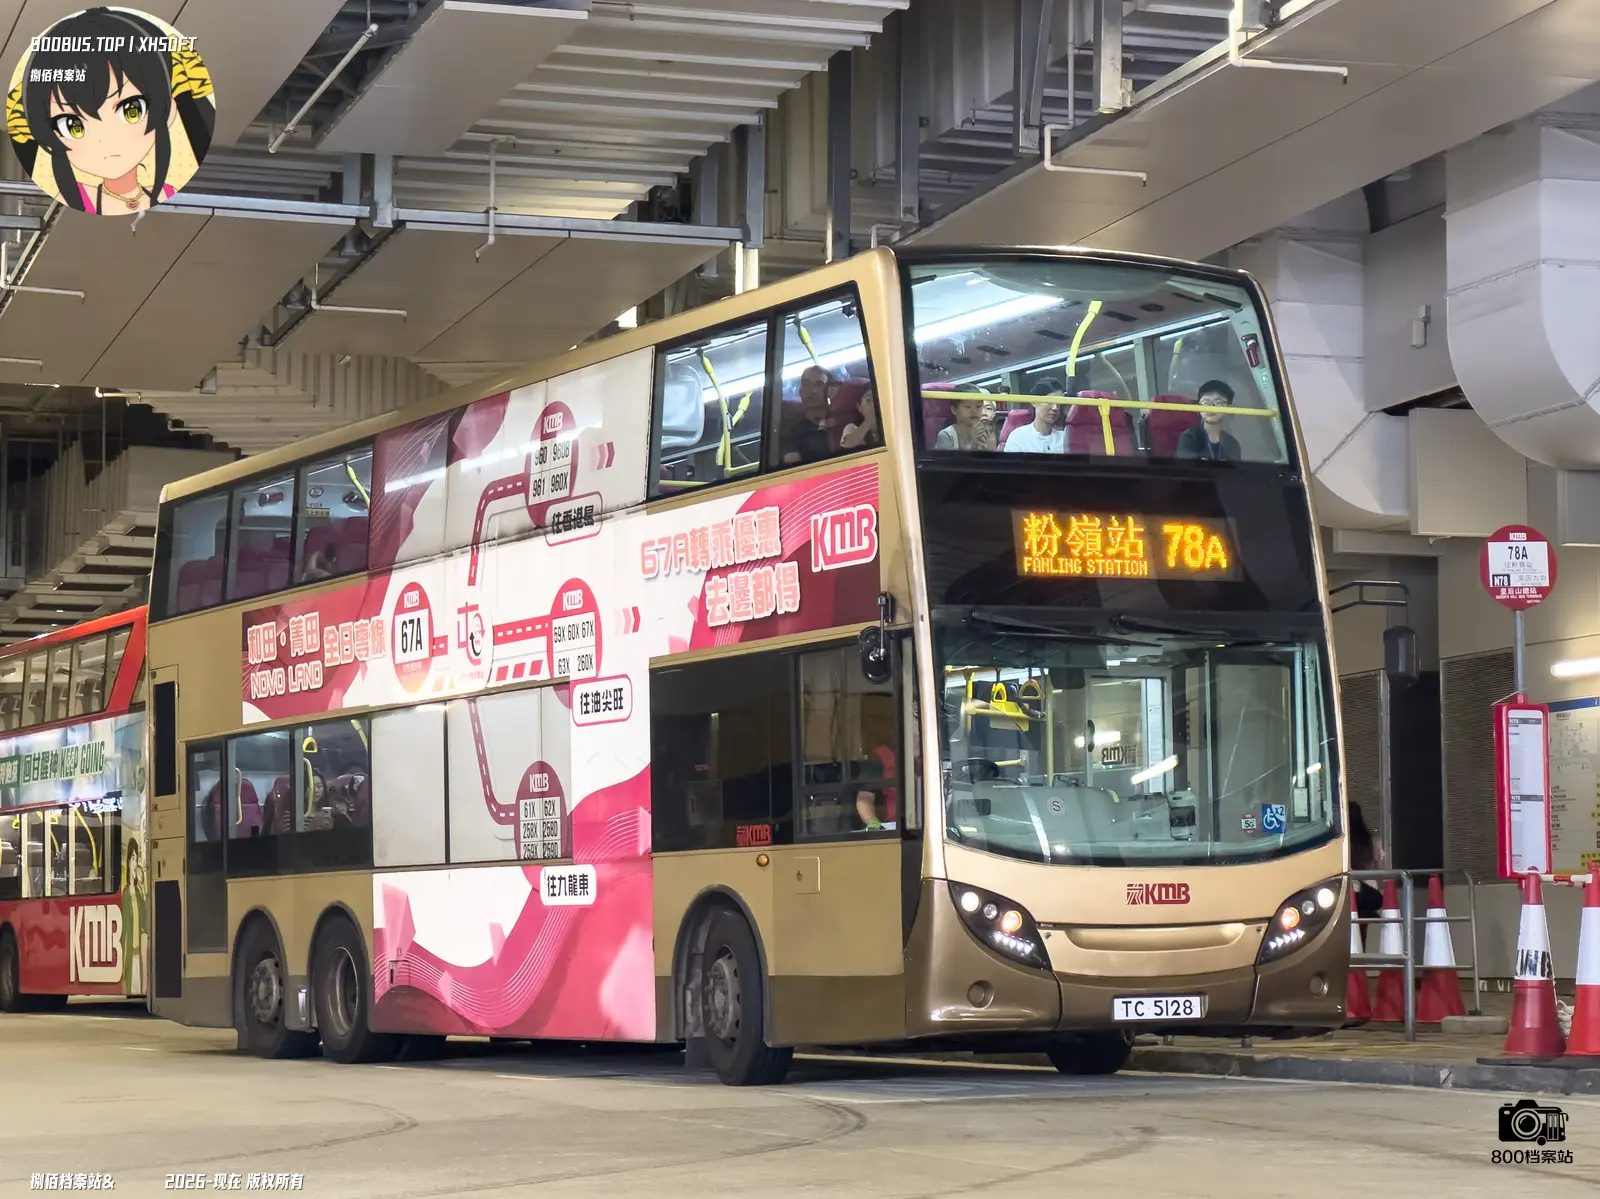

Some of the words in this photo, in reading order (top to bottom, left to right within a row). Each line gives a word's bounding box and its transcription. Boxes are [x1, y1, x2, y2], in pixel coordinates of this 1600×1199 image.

[543, 411, 564, 434] KMB
[532, 478, 546, 498] 961
[550, 471, 569, 494] 960X
[551, 504, 595, 535] 往香港島
[810, 503, 879, 573] KMB
[1022, 511, 1146, 559] 粉嶺站
[1162, 522, 1229, 570] 78A
[1507, 545, 1529, 561] 78A
[1023, 556, 1083, 575] FANLING
[1086, 558, 1149, 577] STATION
[1493, 575, 1509, 587] N78
[403, 590, 420, 609] KMB
[562, 588, 584, 612] KMB
[705, 561, 801, 628] 去邊都得
[323, 615, 388, 668] 全日專線
[401, 617, 423, 654] 67A
[553, 627, 566, 644] 59X
[567, 623, 580, 641] 60X
[581, 620, 595, 639] 67X
[557, 656, 571, 675] 63X
[577, 653, 594, 672] 260X
[251, 666, 286, 700] NOVO
[288, 659, 323, 694] LAND
[579, 686, 624, 715] 往油尖旺
[59, 745, 79, 779] KEEP
[80, 740, 105, 775] GOING
[529, 772, 549, 793] KMB
[523, 801, 537, 819] 61X
[543, 798, 557, 816] 62X
[522, 822, 539, 839] 258X
[547, 873, 589, 897] 往九龍東
[1144, 882, 1191, 905] KMB
[70, 904, 123, 983] KMB
[1121, 1000, 1145, 1018] TC
[1153, 999, 1194, 1017] 5128
